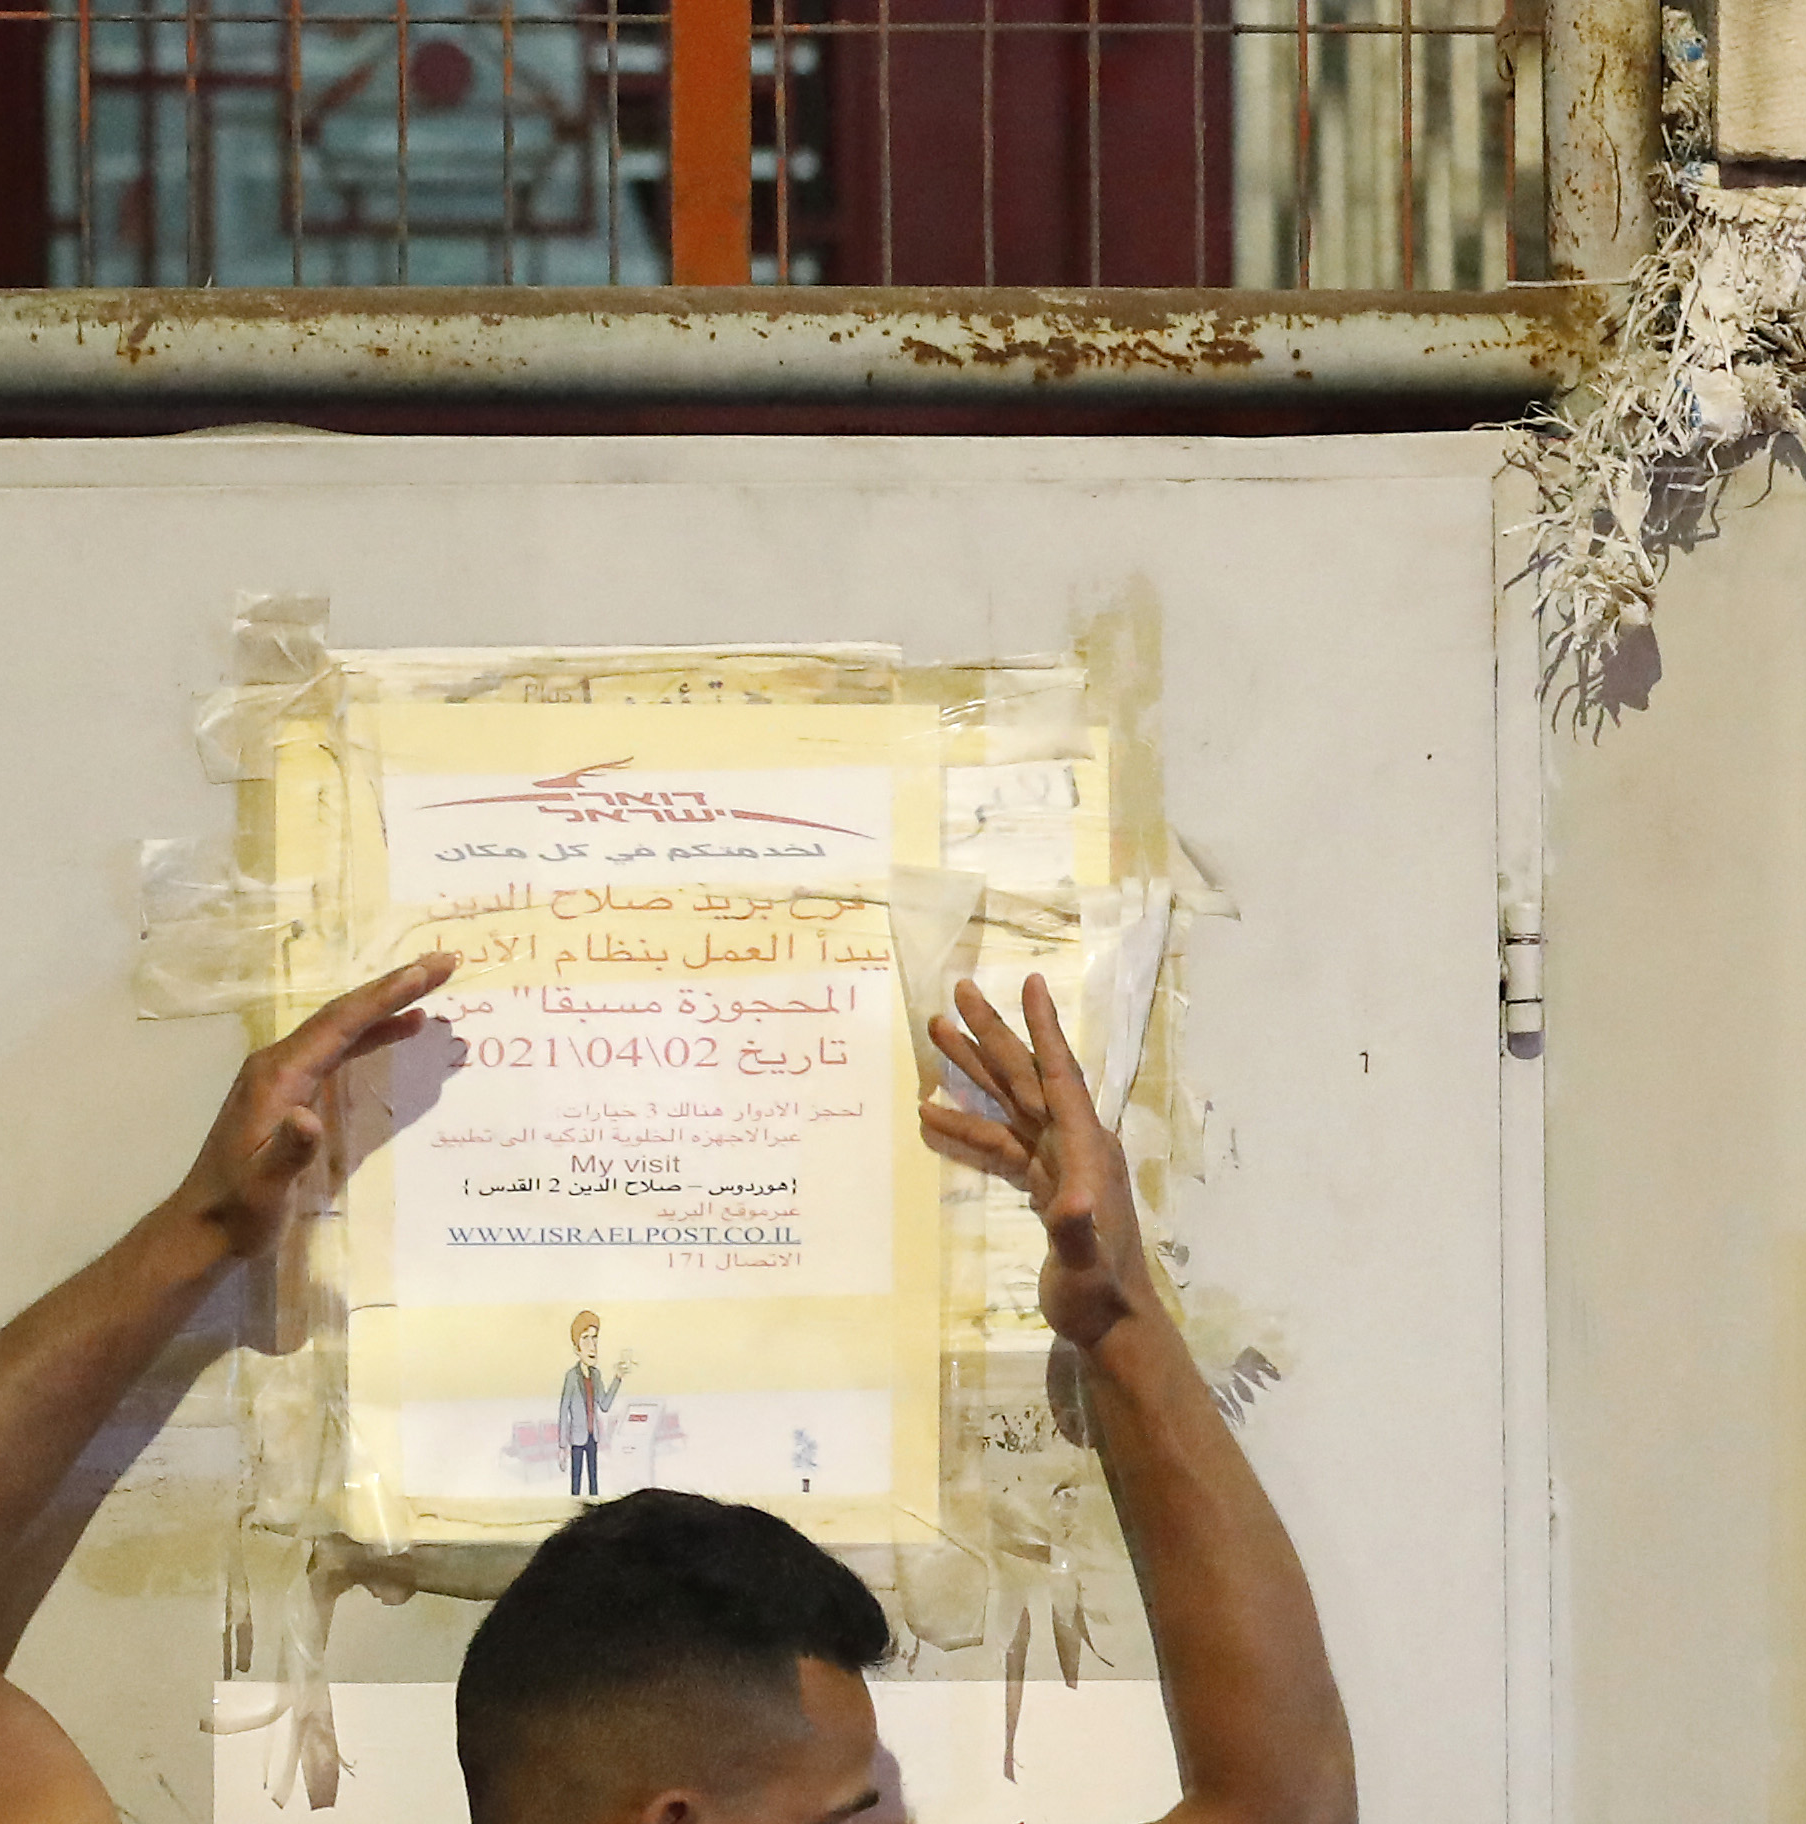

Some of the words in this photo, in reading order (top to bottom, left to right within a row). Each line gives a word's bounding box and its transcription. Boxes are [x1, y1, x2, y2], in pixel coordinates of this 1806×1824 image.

[577, 791, 708, 807] דואר
[537, 806, 726, 823] ישראל
[435, 843, 528, 863] مكان
[538, 843, 589, 863] كل
[605, 842, 657, 866] في
[551, 883, 673, 920] صلاح
[555, 932, 669, 976] بنظام
[683, 931, 794, 970] العمل
[678, 984, 856, 1023] المحجوزة
[738, 1036, 849, 1075] تاريخ
[649, 1102, 658, 1117] 3
[570, 1153, 615, 1178] My
[624, 1153, 681, 1174] visit
[478, 1177, 541, 1196] القدس
[548, 1177, 561, 1193] 2
[568, 1178, 618, 1196] الدين
[624, 1178, 682, 1196] صلاح
[446, 1226, 802, 1245] WWW.ISRAELPOST.CO.IL
[667, 1252, 706, 1269] 171
